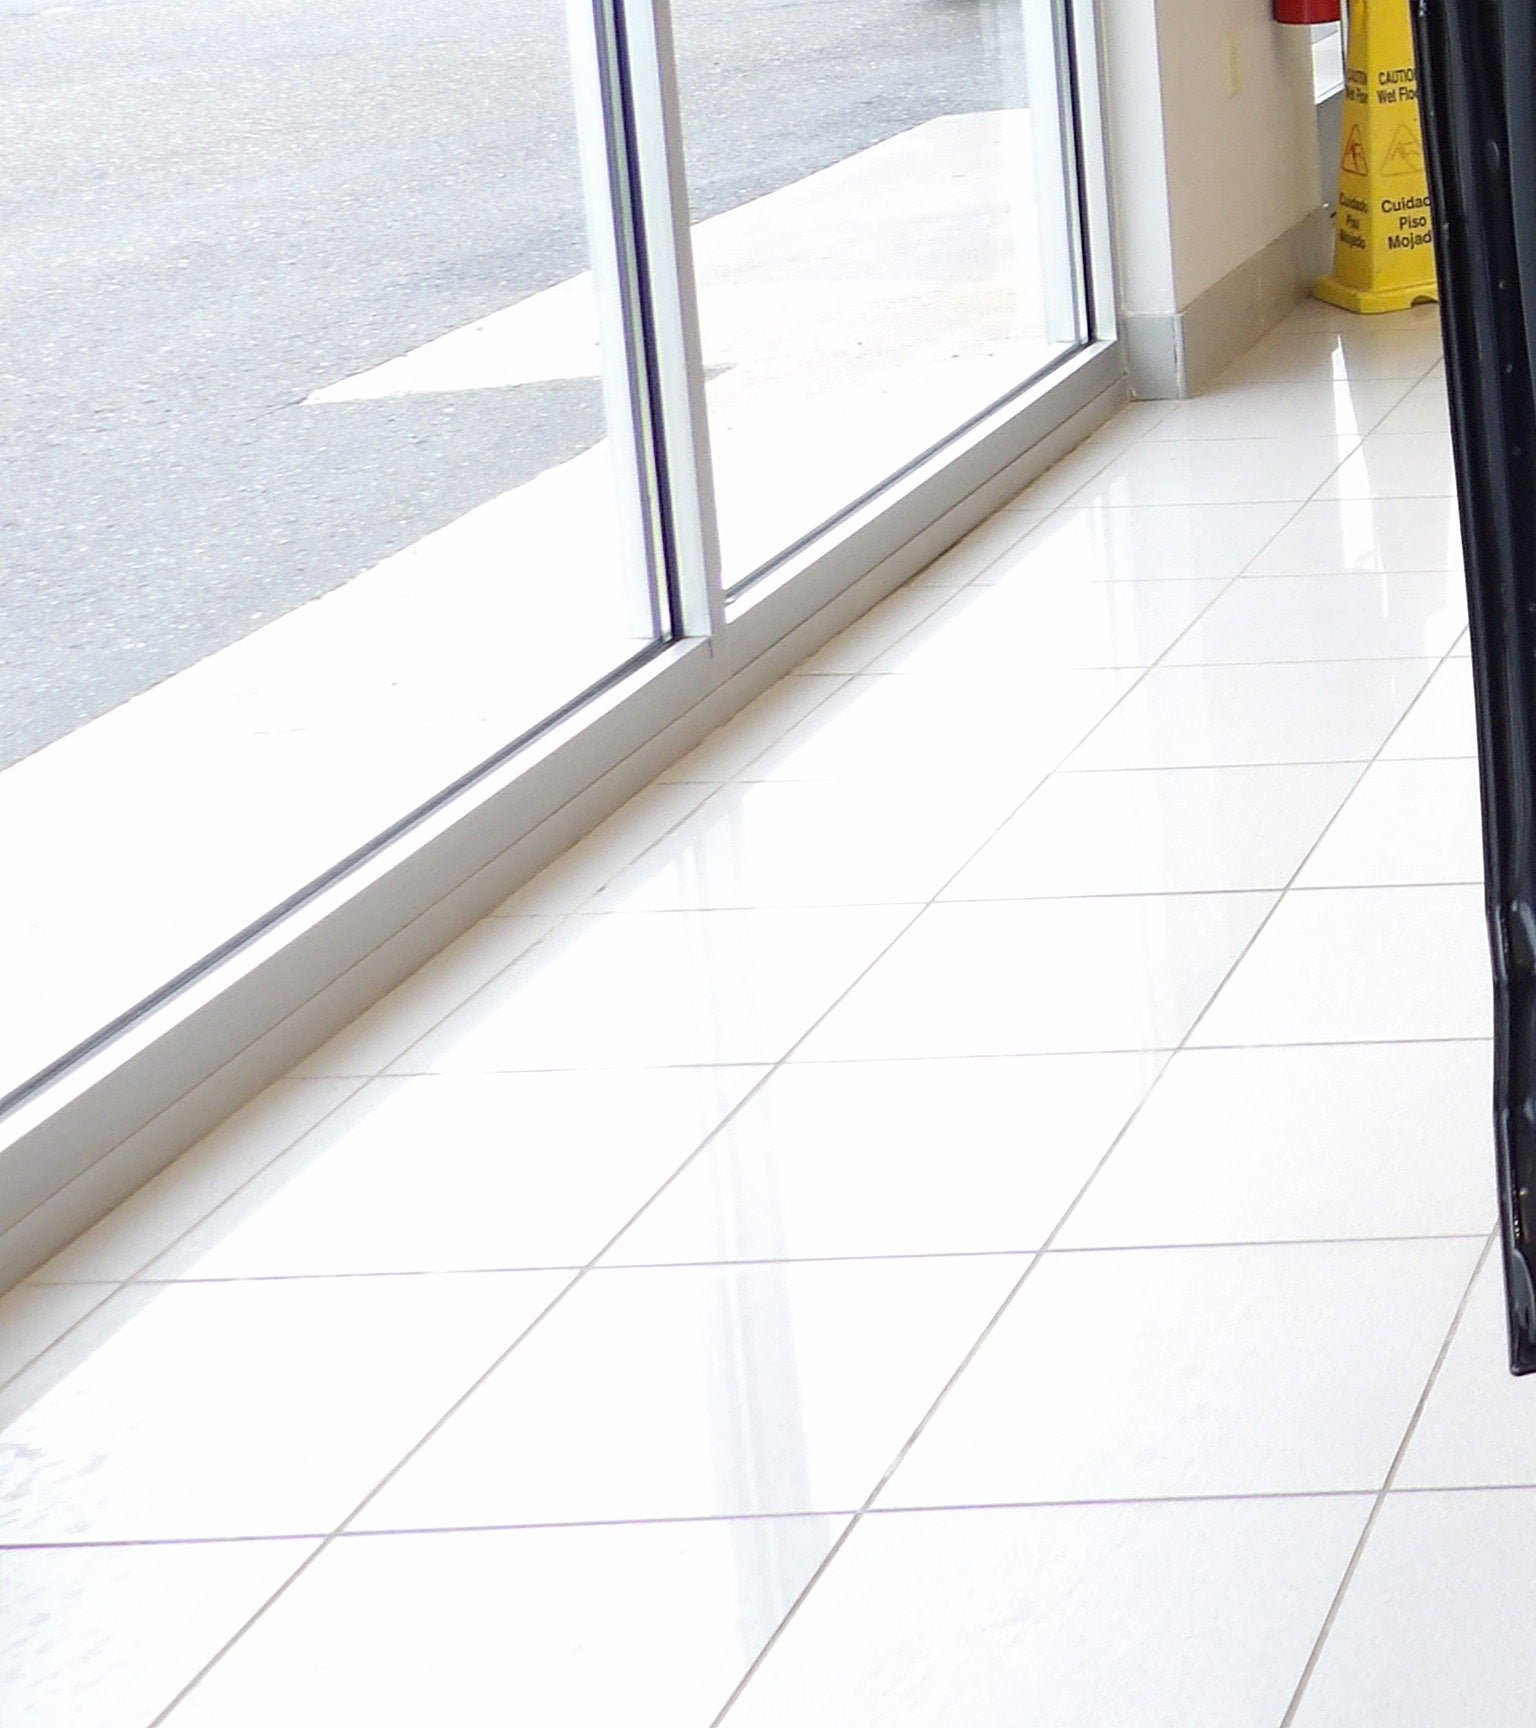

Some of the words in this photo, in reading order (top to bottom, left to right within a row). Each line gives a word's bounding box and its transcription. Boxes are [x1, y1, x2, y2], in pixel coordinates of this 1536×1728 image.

[1378, 68, 1414, 85] CAUTIO
[1376, 89, 1397, 104] Wet
[1381, 196, 1432, 213] Cuidad
[1399, 215, 1427, 230] Piso
[1387, 230, 1432, 250] Mojad
